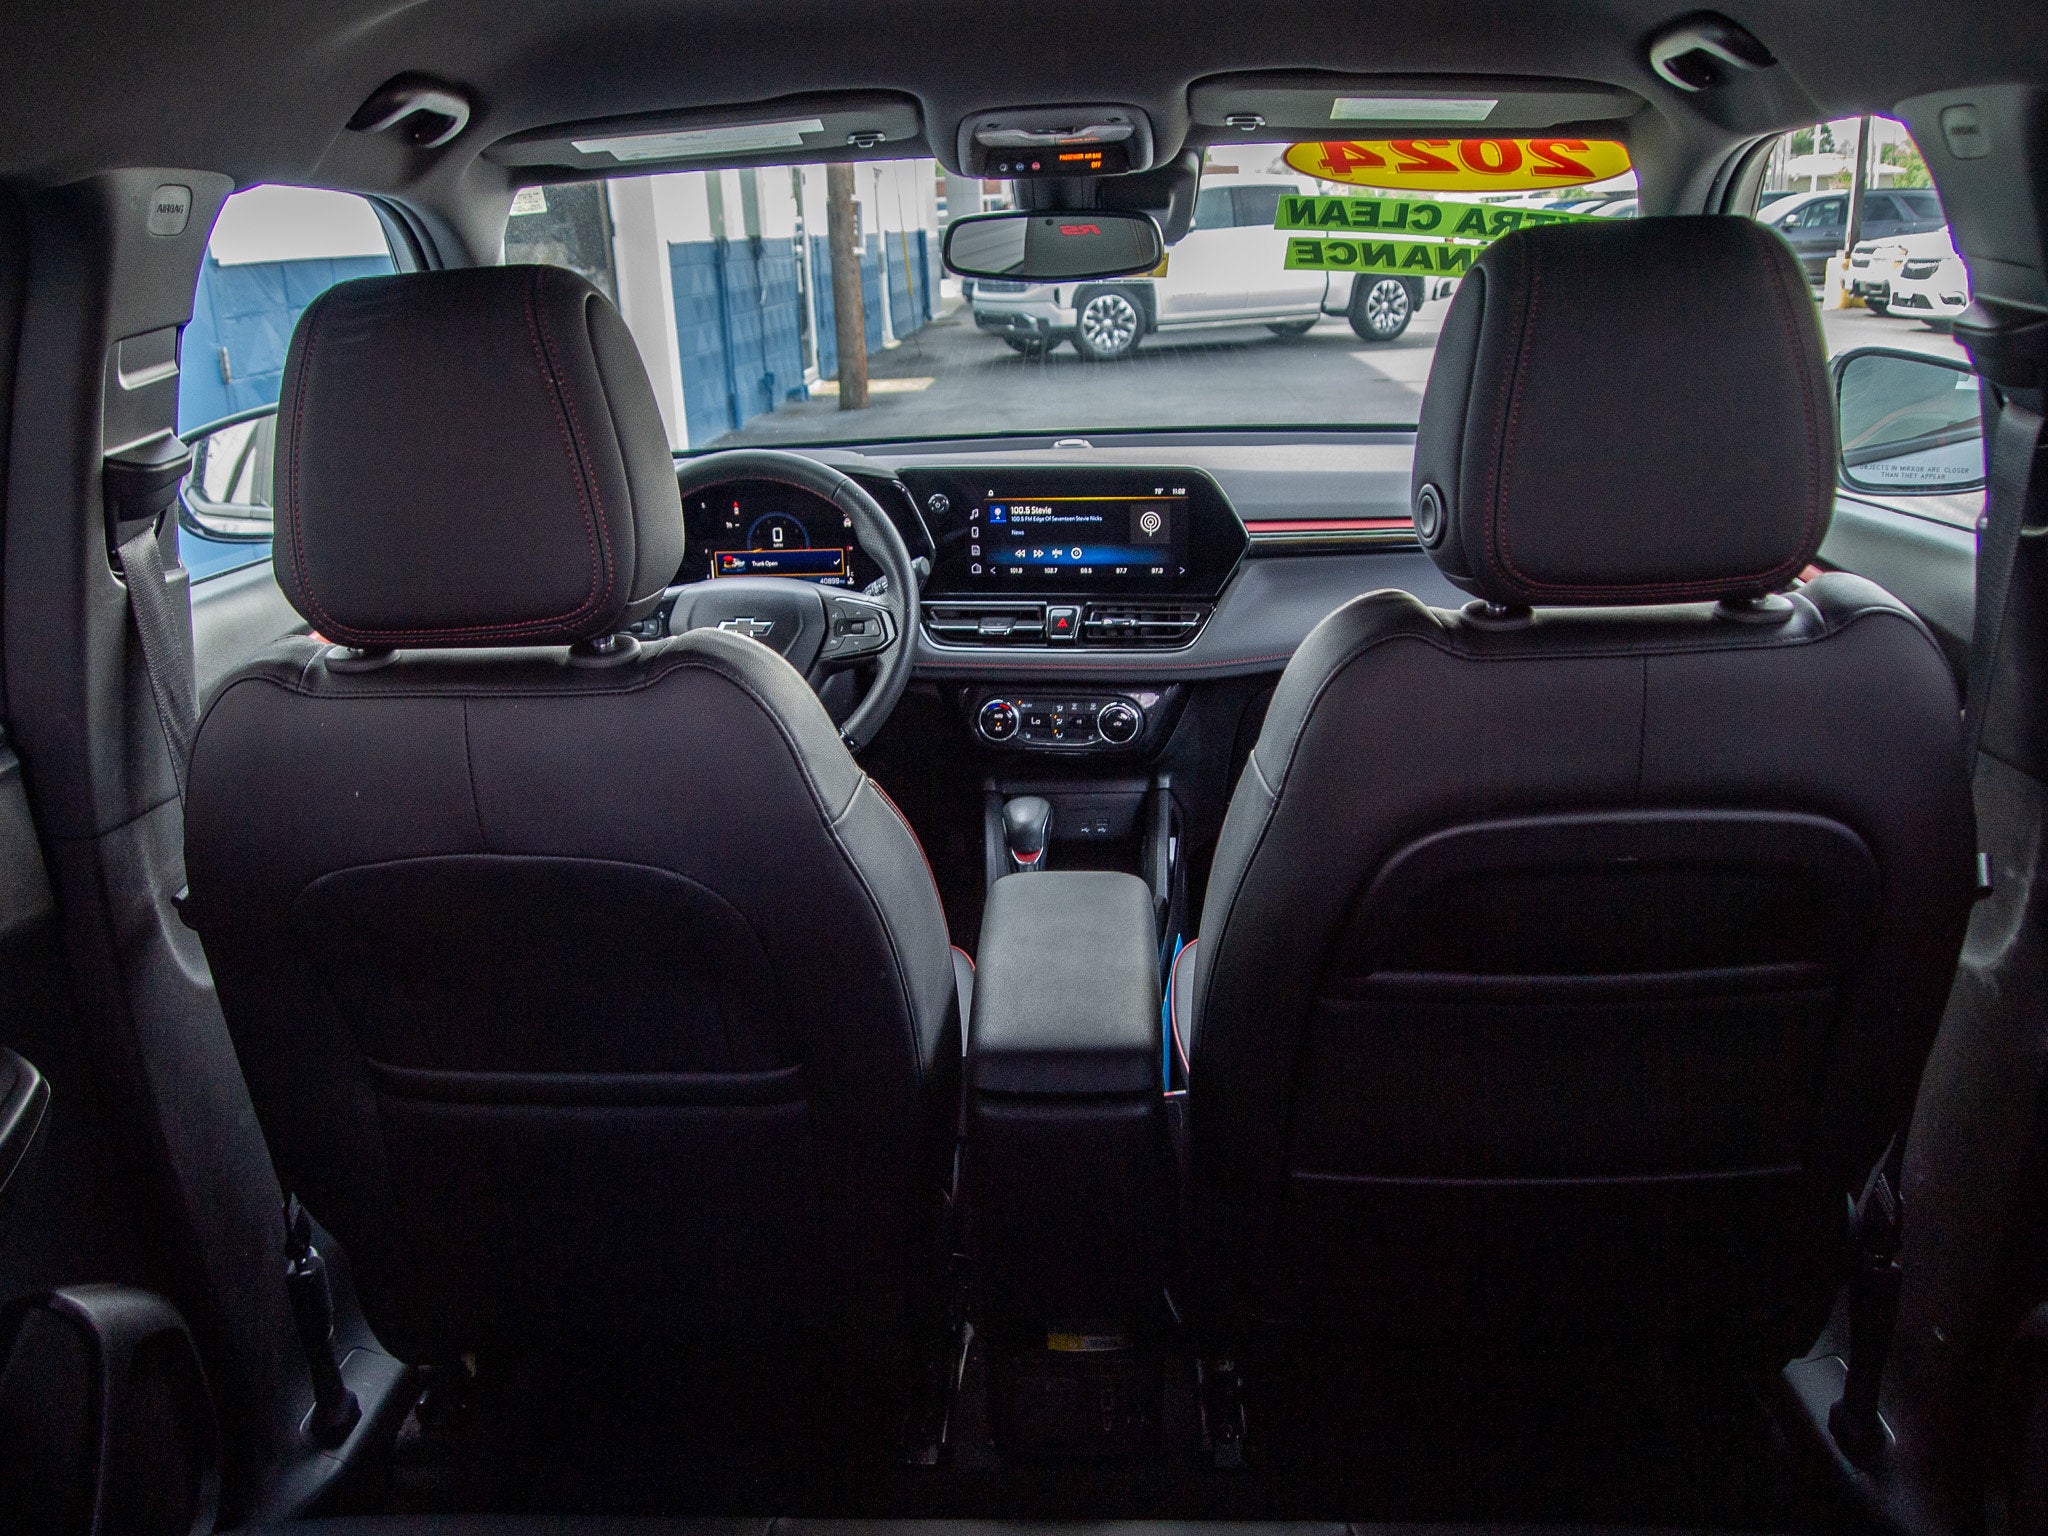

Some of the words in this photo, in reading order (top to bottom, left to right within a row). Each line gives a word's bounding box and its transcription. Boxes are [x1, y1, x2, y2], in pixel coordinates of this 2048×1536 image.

[1091, 161, 1101, 169] OFF
[156, 203, 185, 214] AIRBAG
[1010, 506, 1031, 515] 100.5
[1031, 506, 1052, 515] Stevie
[772, 527, 783, 542] 0
[1031, 716, 1041, 725] Lo
